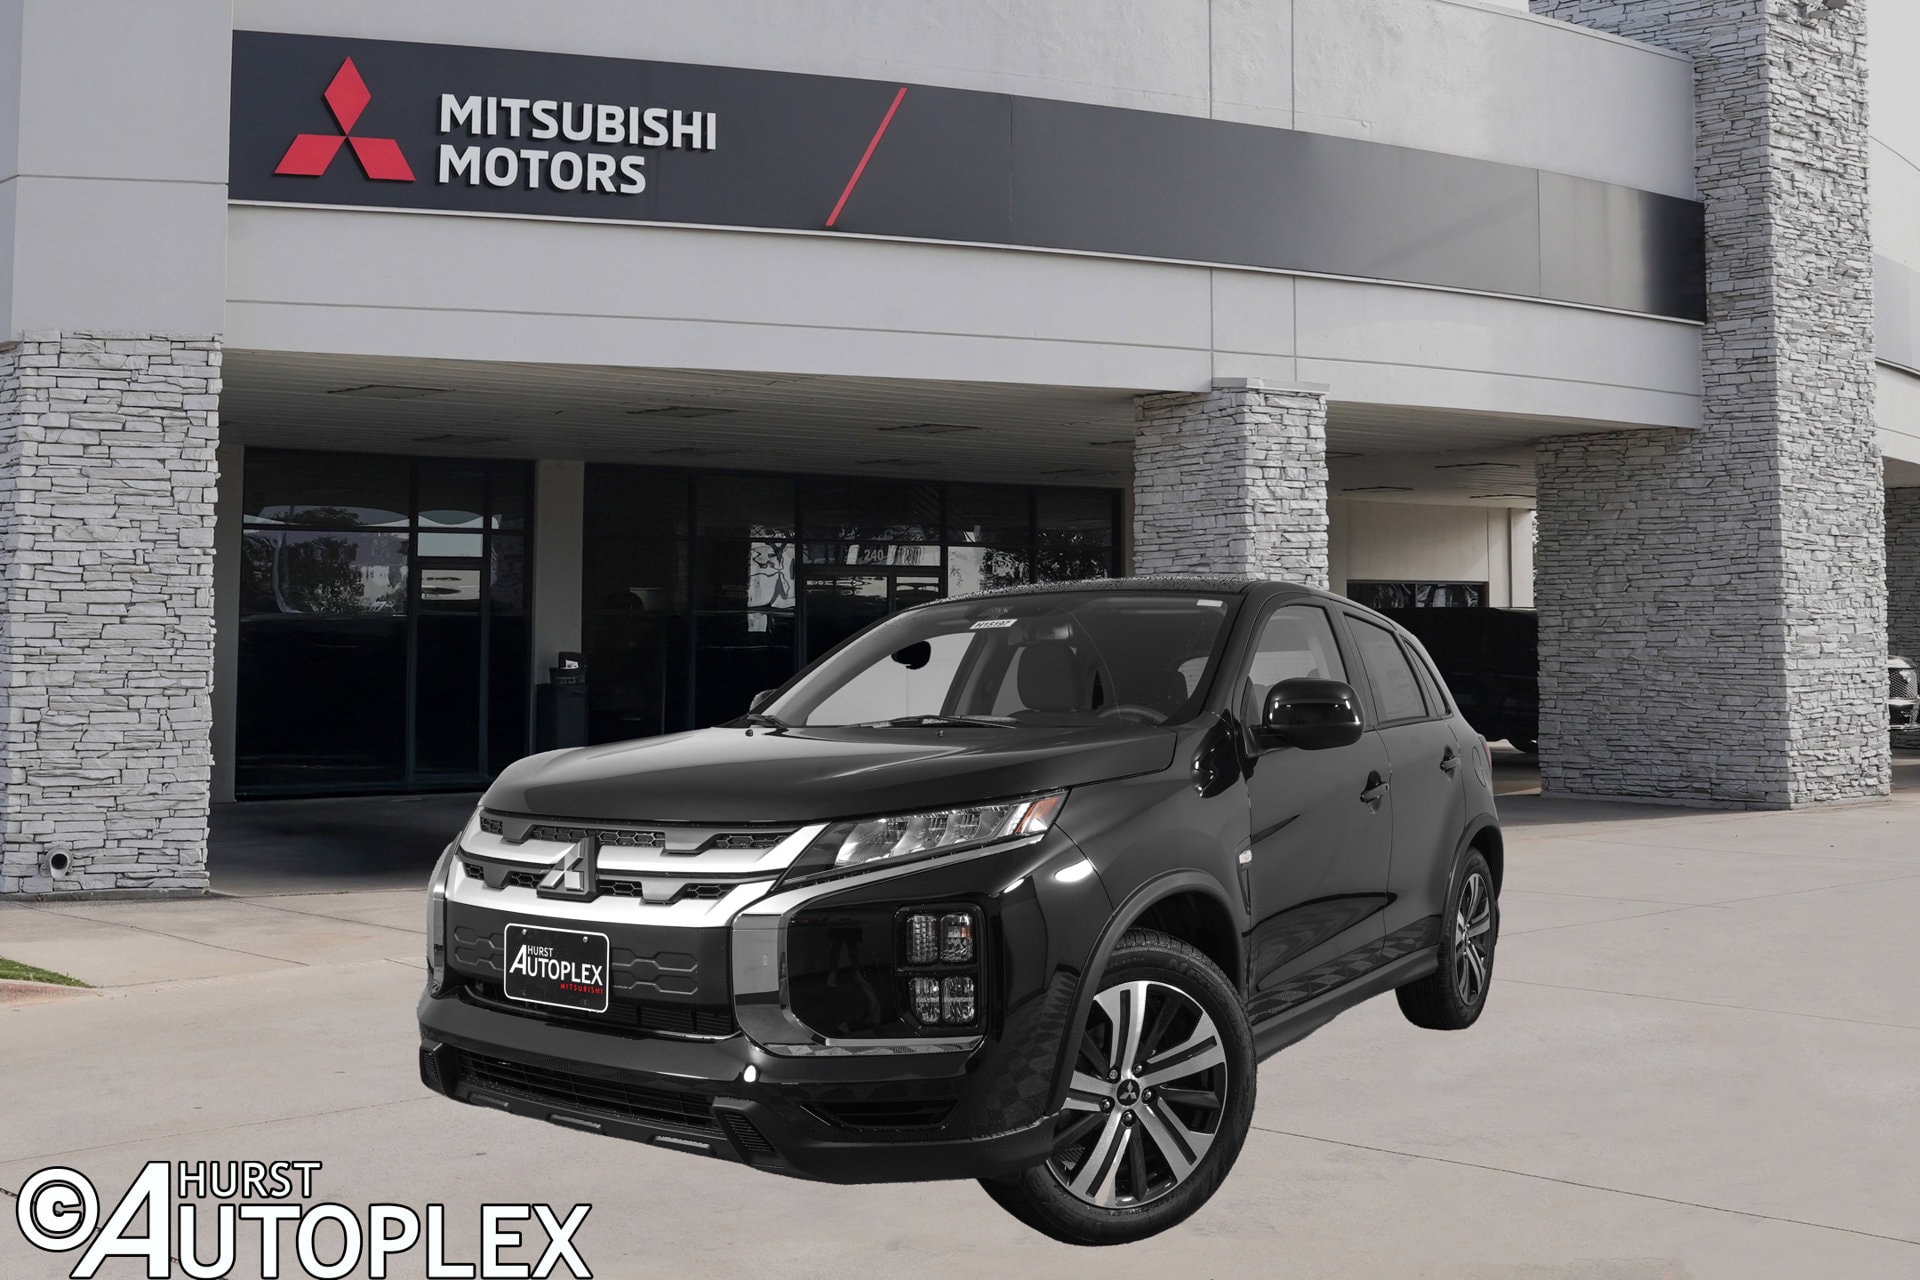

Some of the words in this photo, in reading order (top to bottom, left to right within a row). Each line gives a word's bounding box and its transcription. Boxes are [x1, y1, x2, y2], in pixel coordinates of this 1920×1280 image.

[440, 93, 717, 151] MITSUBISHI
[438, 144, 647, 195] MOTORS
[863, 549, 884, 561] 240
[527, 945, 554, 957] HURST
[509, 944, 603, 986] AUTOPLEX
[559, 983, 604, 995] MITSUBISHI
